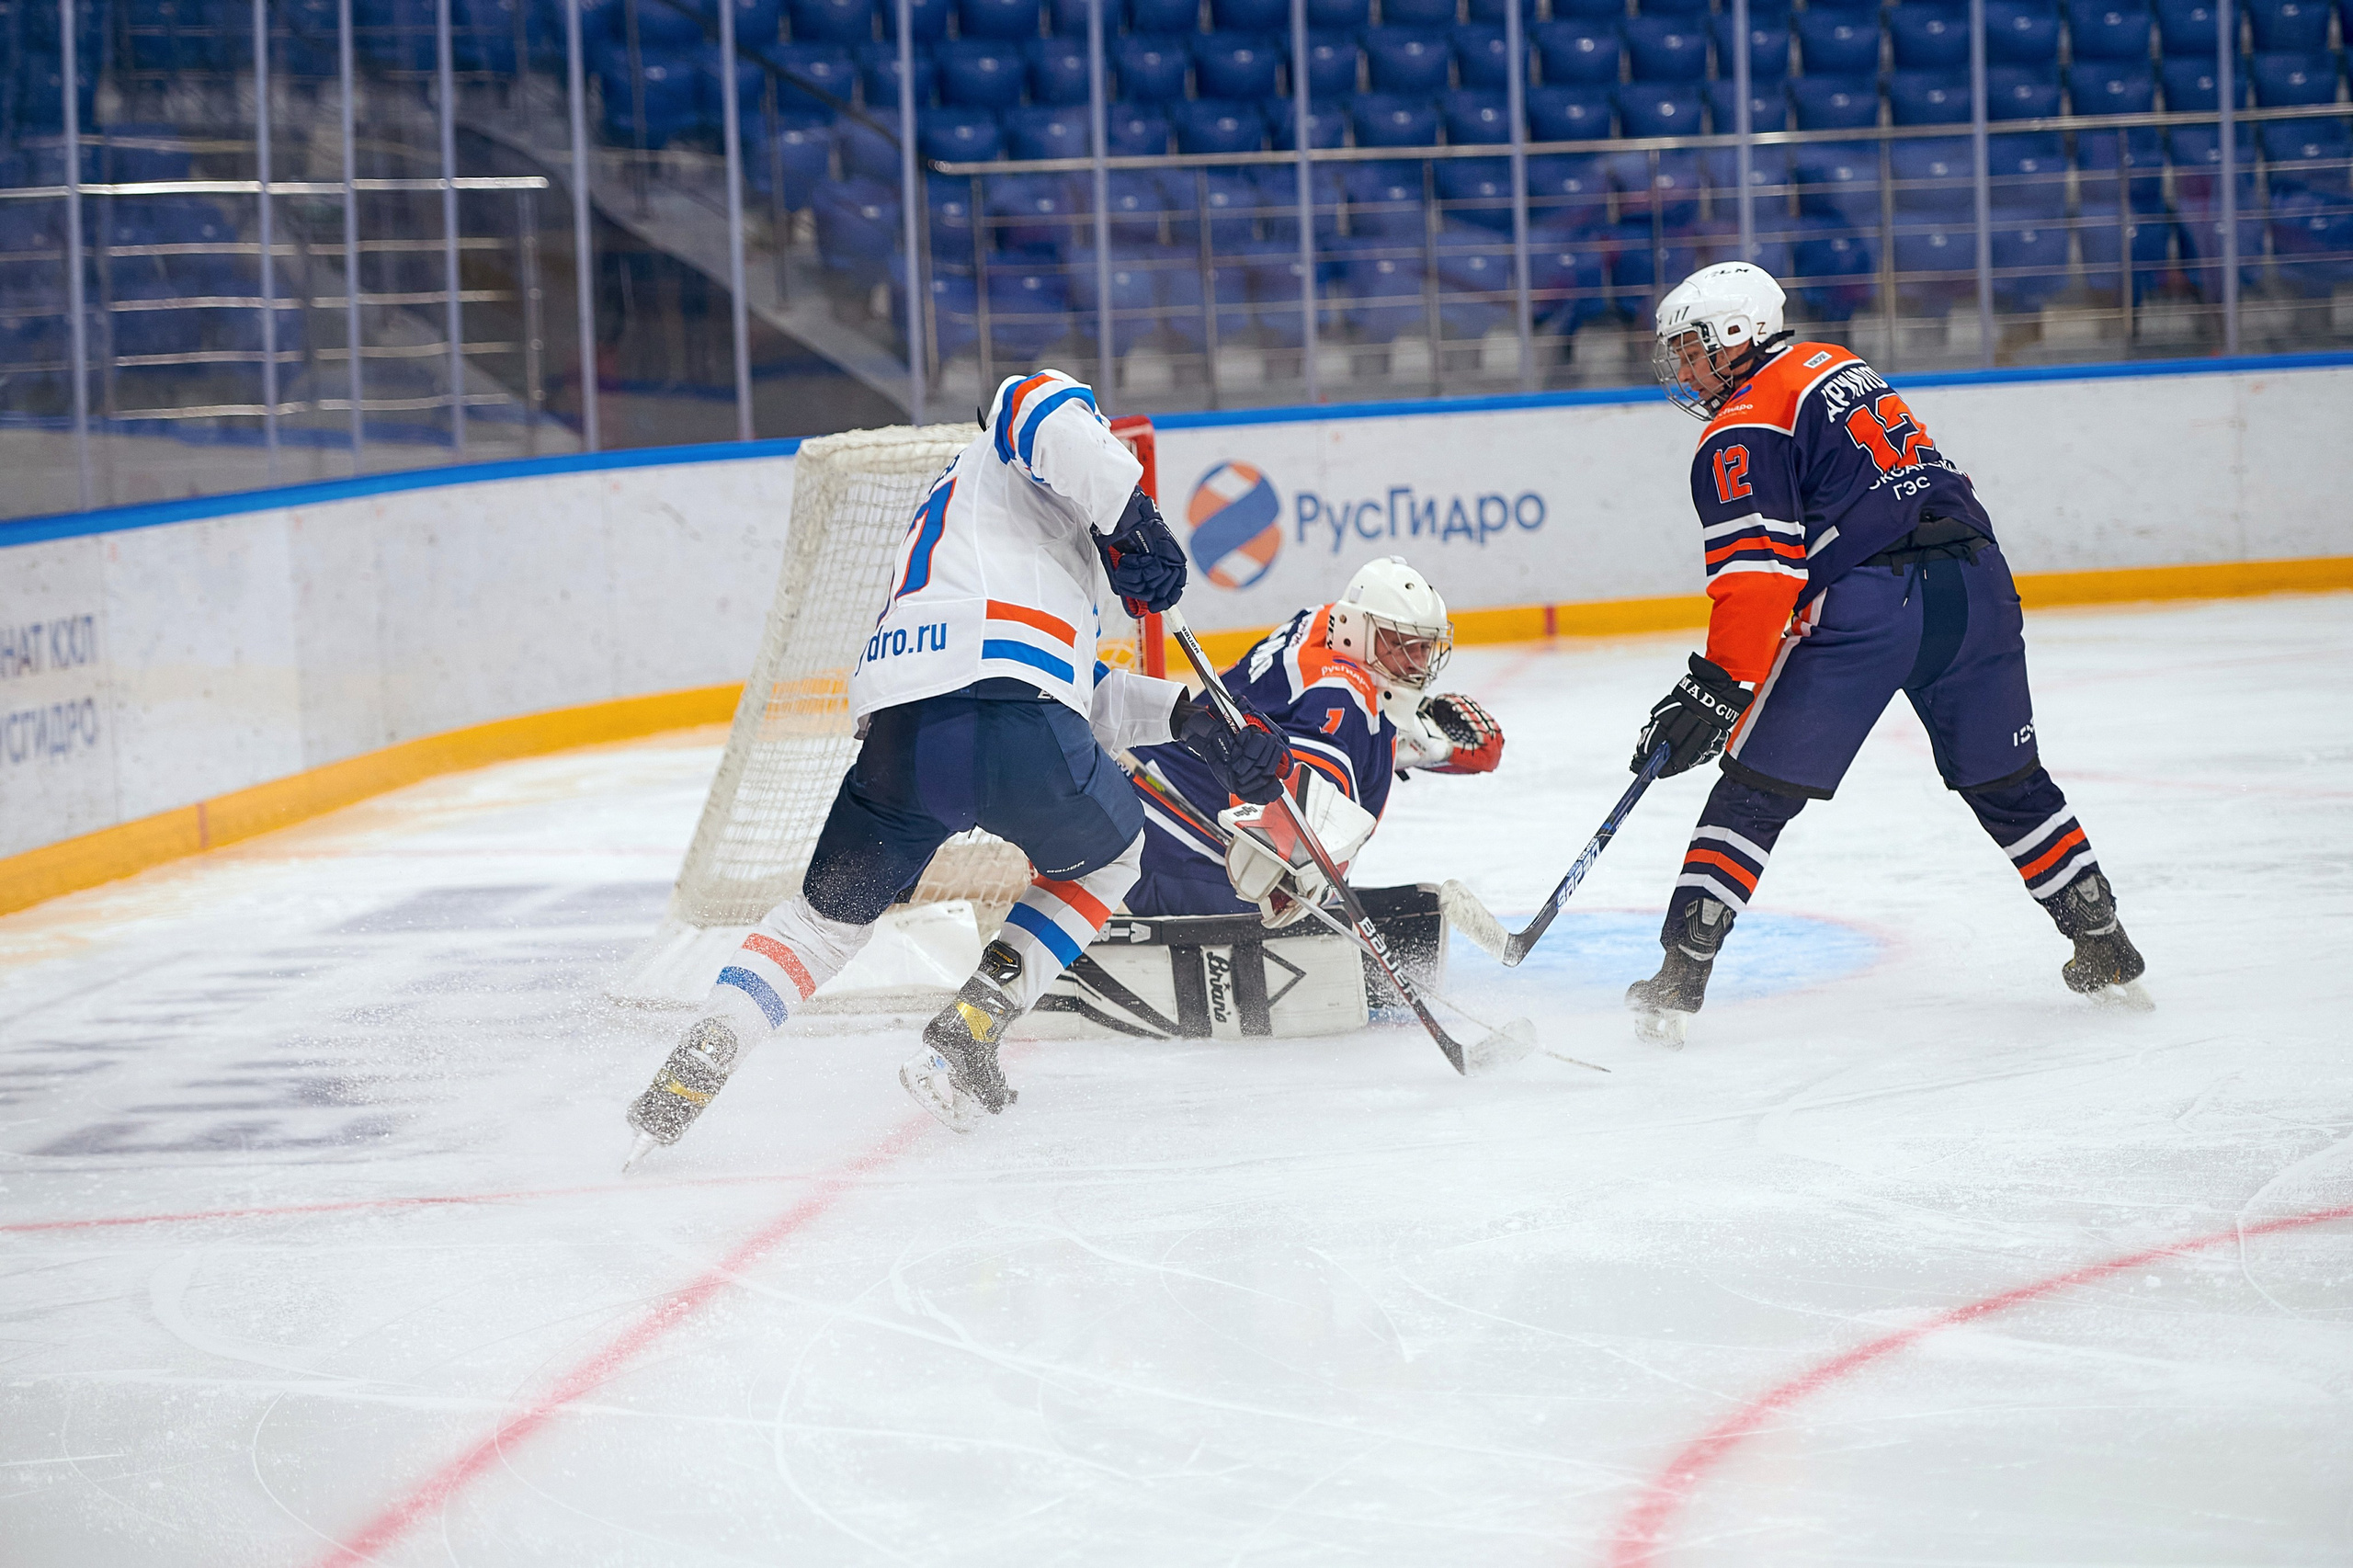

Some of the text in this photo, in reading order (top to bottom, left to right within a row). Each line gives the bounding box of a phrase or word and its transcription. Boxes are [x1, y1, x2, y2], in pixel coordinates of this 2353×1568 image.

[1712, 444, 1753, 504] 12
[1893, 476, 1931, 501] ГЭС
[1294, 483, 1547, 554] РусГидро
[1320, 707, 1346, 735] 1
[1678, 676, 1740, 723] MAD GUY
[1206, 950, 1232, 1024] Brian's
[1358, 915, 1421, 1006] BAUER
